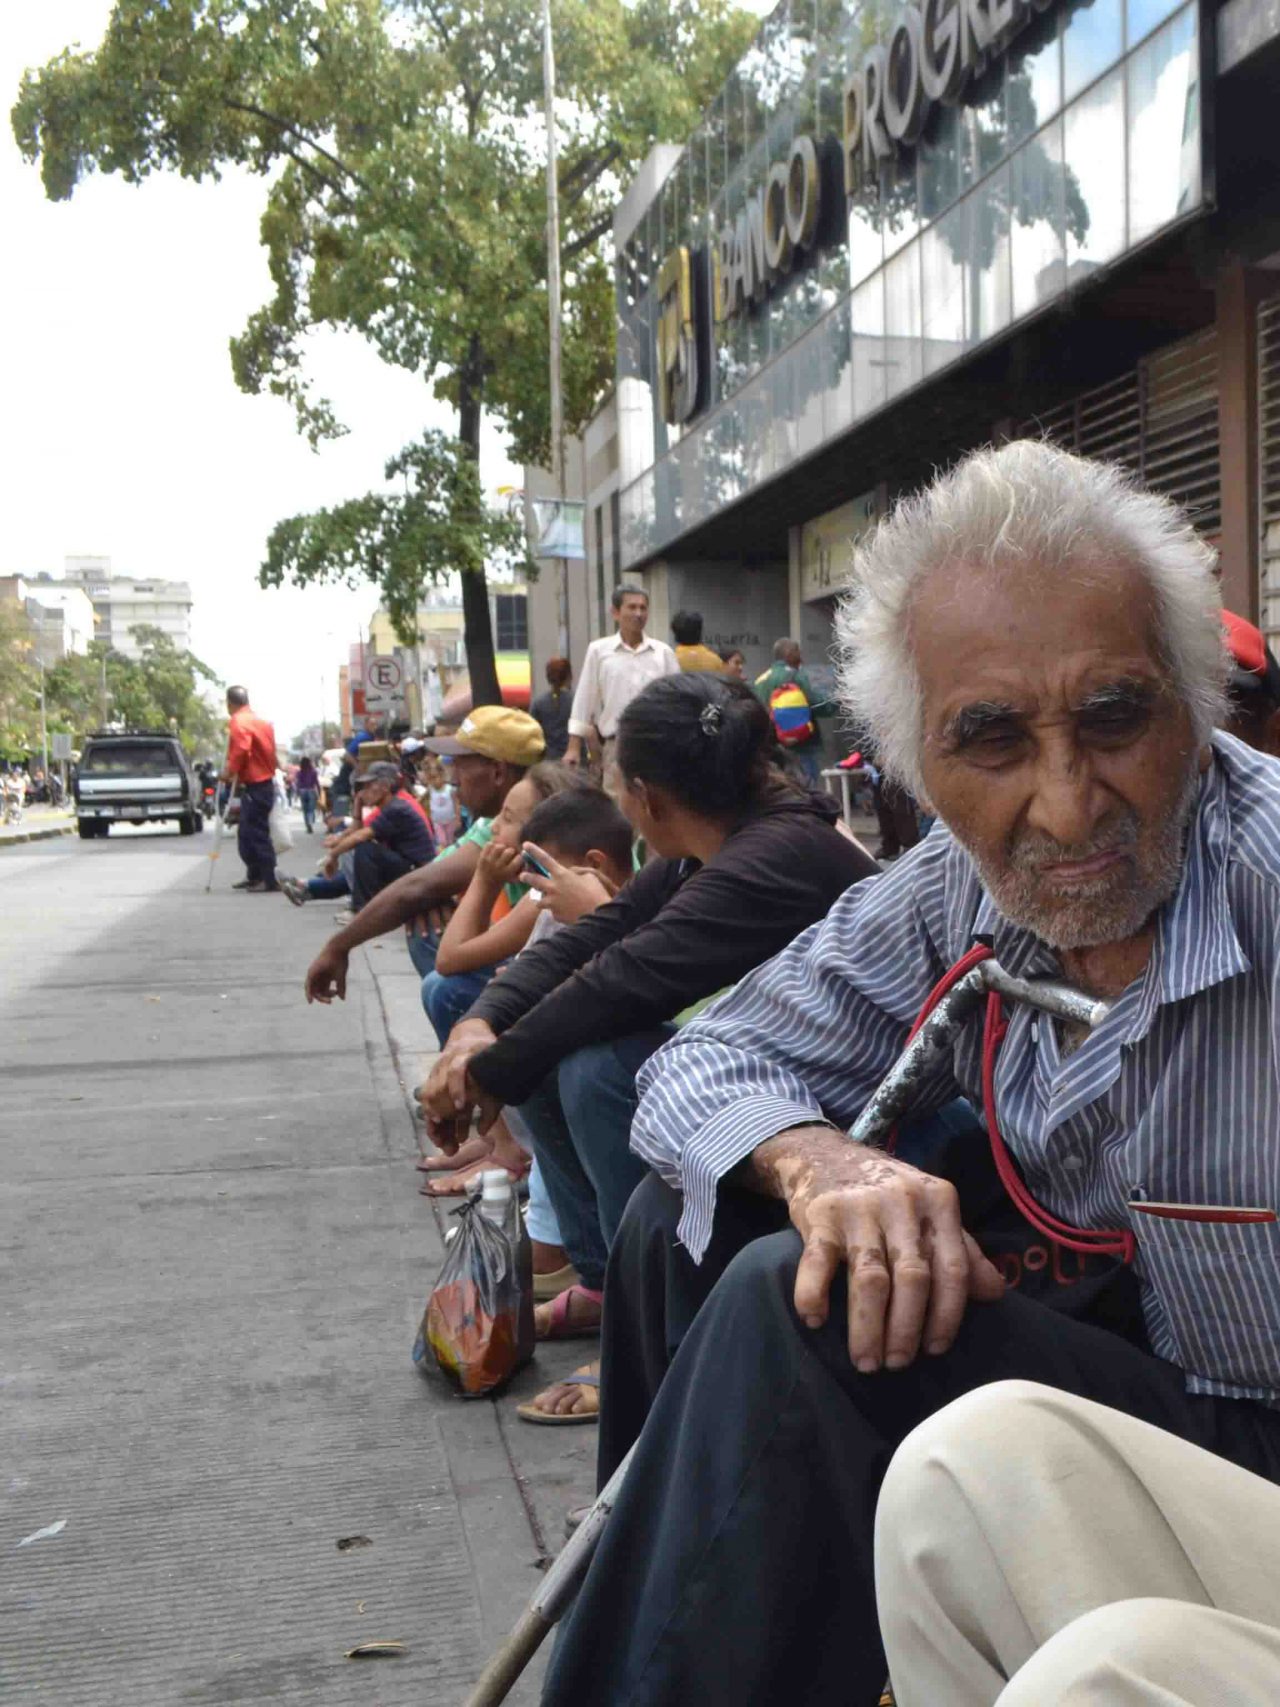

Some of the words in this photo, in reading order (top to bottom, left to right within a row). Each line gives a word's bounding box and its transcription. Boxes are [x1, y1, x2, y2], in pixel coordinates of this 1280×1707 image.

[711, 134, 819, 323] BANCO
[843, 0, 1013, 195] PROGR
[378, 664, 392, 685] E
